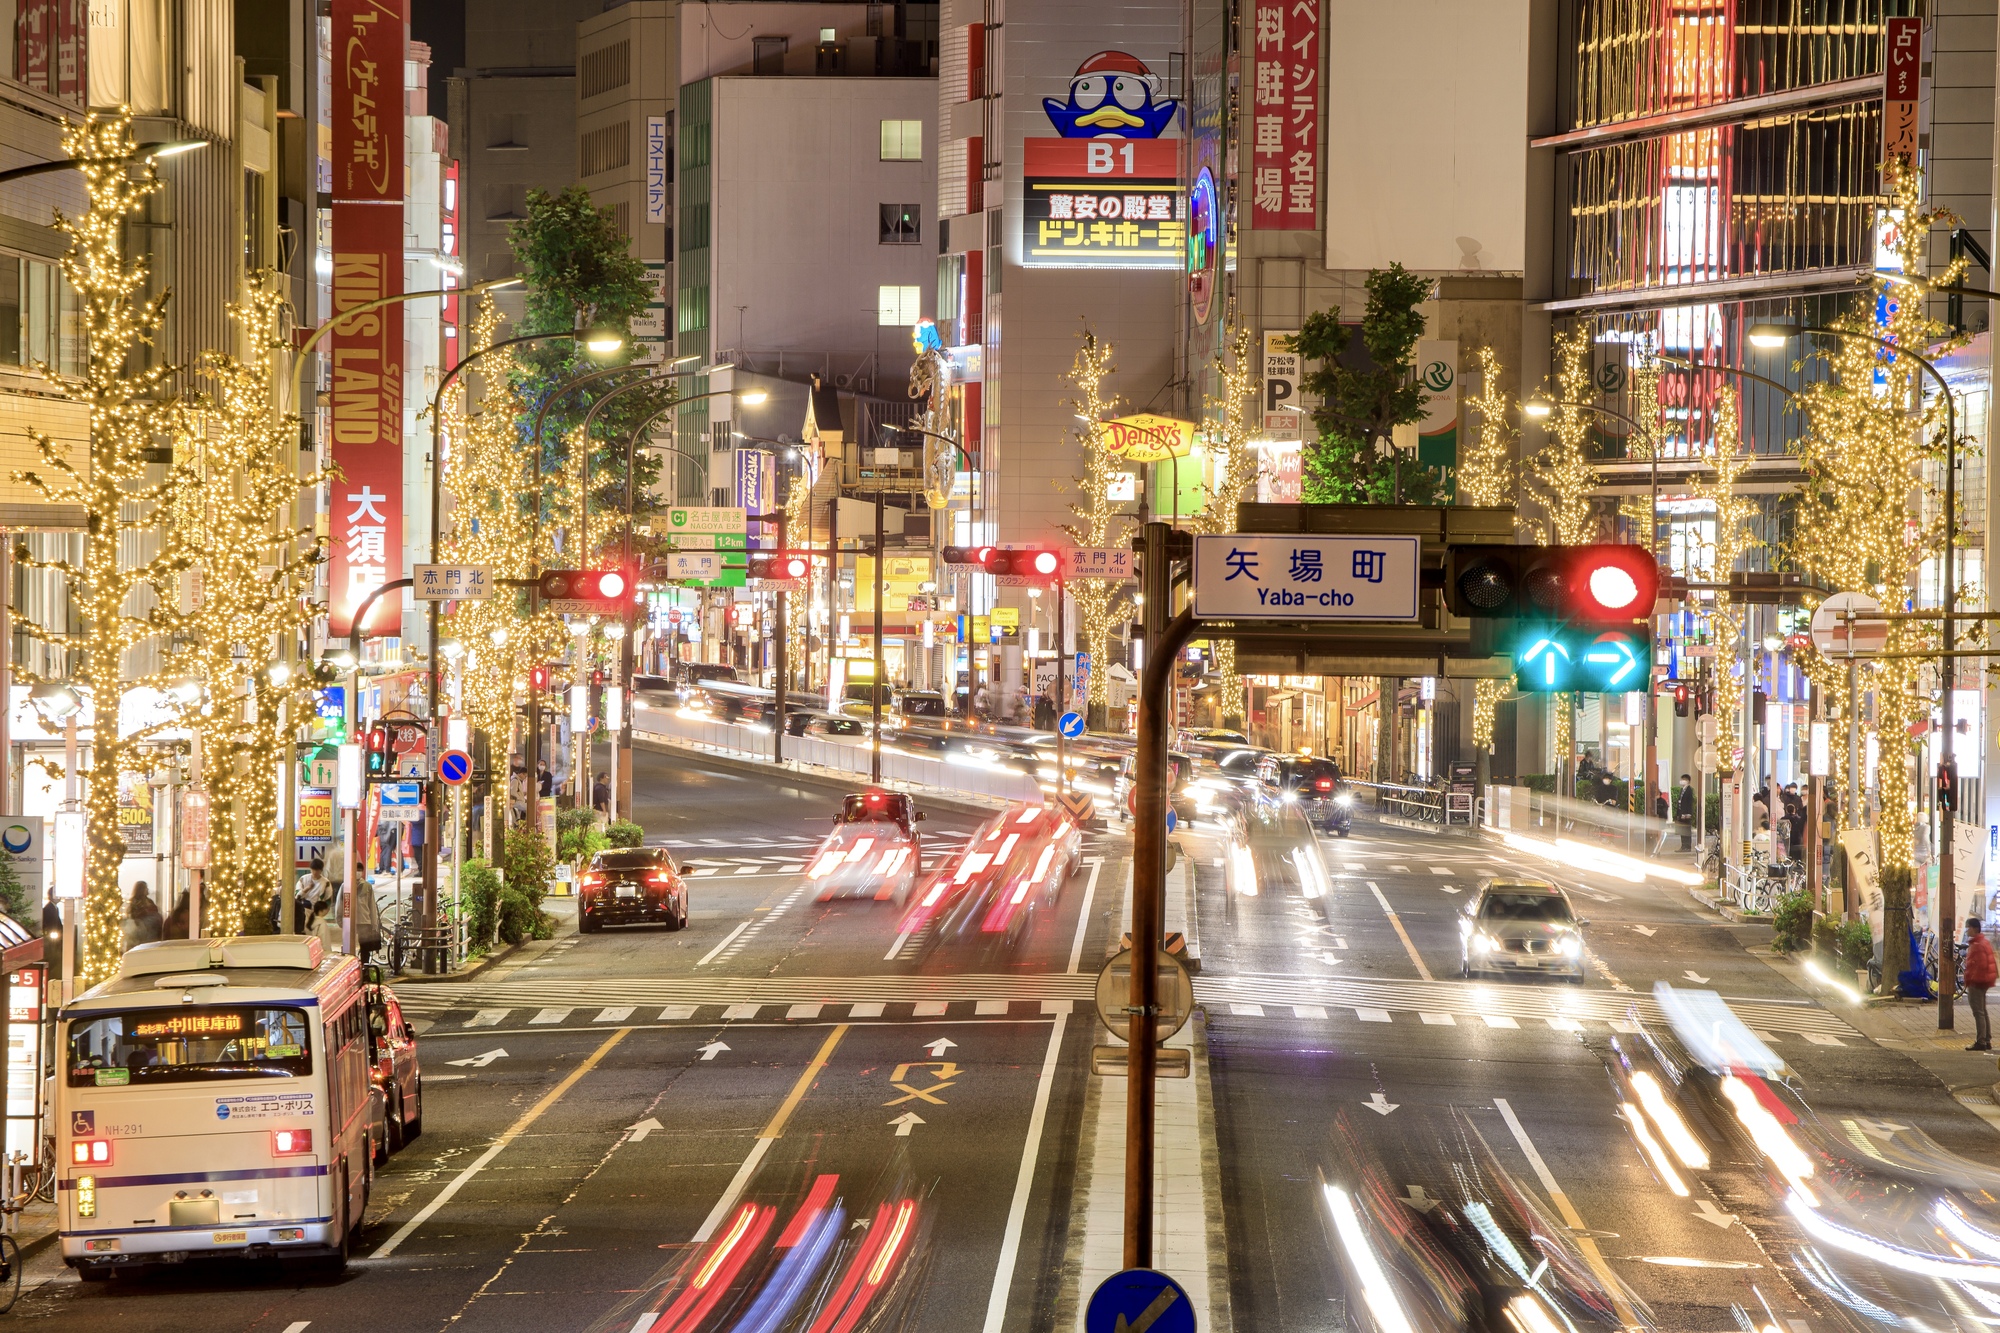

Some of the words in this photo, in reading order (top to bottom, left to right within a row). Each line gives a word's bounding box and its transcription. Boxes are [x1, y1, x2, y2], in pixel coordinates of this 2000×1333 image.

[1893, 24, 1917, 66] 占い
[351, 60, 379, 170] ゲームデポ
[1087, 142, 1134, 174] B1
[649, 123, 664, 216] エヌエスディ
[1048, 193, 1172, 220] 驚安の殿堂
[334, 253, 380, 337] KIDS
[633, 320, 657, 329] Walking
[1267, 356, 1295, 366] 万松寺
[1267, 367, 1295, 376] 駐車場
[334, 349, 380, 444] LAND
[382, 363, 400, 446] SUPER
[1110, 419, 1181, 450] Denny's
[673, 513, 685, 522] C1
[690, 511, 742, 522] 名古屋高速
[346, 486, 387, 603] 大須店
[677, 557, 712, 568] 赤門
[1073, 551, 1126, 565] 赤門北
[1224, 547, 1388, 583] 矢場町
[422, 569, 484, 585] 赤門北
[1075, 565, 1104, 574] Akamon
[1109, 565, 1124, 574] Kita
[425, 586, 459, 595] Akamon
[464, 586, 482, 595] Kita
[1257, 588, 1355, 607] Yaba-cho
[555, 602, 612, 611] スクランブル式
[23, 972, 34, 985] 5
[105, 1124, 142, 1136] NH-291
